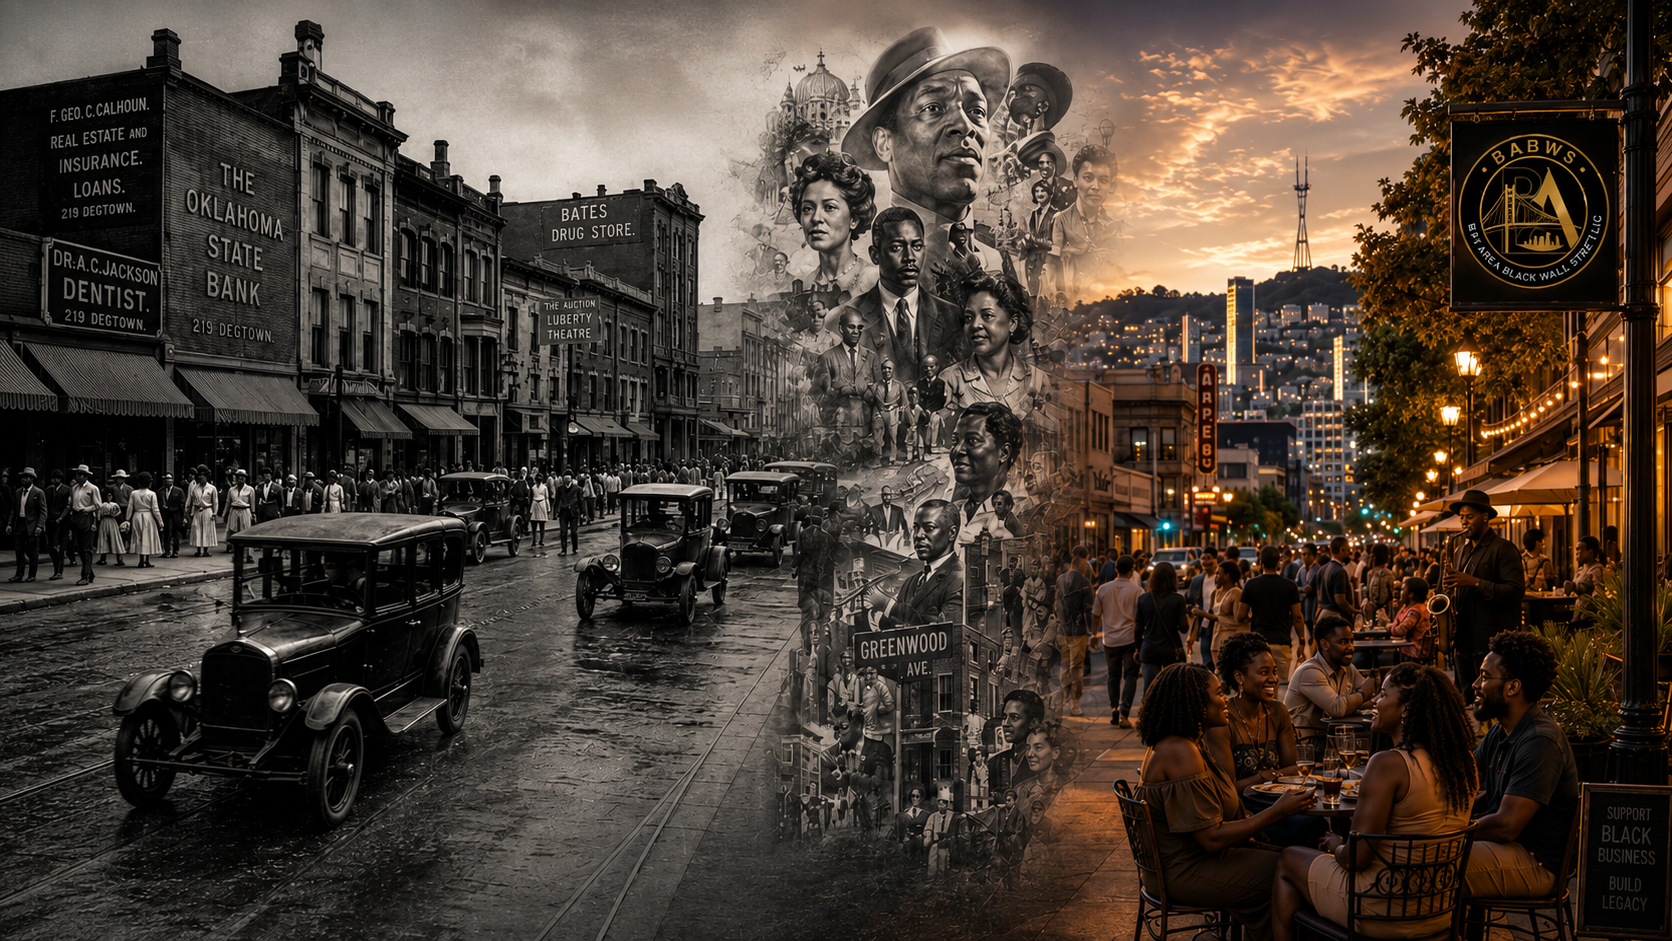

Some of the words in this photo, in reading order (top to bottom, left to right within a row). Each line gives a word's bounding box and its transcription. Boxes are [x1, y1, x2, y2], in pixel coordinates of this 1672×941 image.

[50, 109, 59, 123] F.
[61, 106, 84, 122] GEO.
[96, 97, 150, 117] CALHOUN.
[51, 133, 79, 149] REAL
[83, 127, 125, 146] ESTATE
[129, 127, 148, 139] AND
[60, 150, 143, 174] INSURANCE.
[1490, 138, 1577, 166] BABWS
[74, 178, 126, 198] LOANS.
[220, 161, 256, 196] THE
[62, 207, 79, 219] 219
[83, 202, 136, 217] DEGTOWN.
[186, 189, 284, 242] OKLAHOMA
[561, 204, 608, 222] BATES
[551, 228, 585, 242] DRUG
[591, 222, 636, 239] STORE.
[207, 233, 264, 272] STATE
[1502, 266, 1537, 282] BLACK
[1539, 264, 1571, 281] WALL
[63, 276, 150, 313] DENTIST.
[207, 270, 261, 307] BANK
[543, 301, 560, 311] THE
[563, 299, 596, 309] AUCTION
[64, 308, 85, 324] 219
[91, 312, 147, 332] DEGTOWN.
[547, 312, 593, 326] LUBERTY
[192, 318, 214, 335] 219
[219, 322, 276, 344] DEGTOWN.
[547, 327, 592, 340] THEATRE
[860, 631, 948, 660] GREENWOOD
[906, 660, 932, 677] AVE.
[1606, 806, 1652, 821] SUPPORT
[1601, 824, 1652, 845] BLACK
[1598, 847, 1656, 865] BUSINESS
[1609, 875, 1642, 892] BUILD
[1601, 894, 1648, 911] LEGACY
